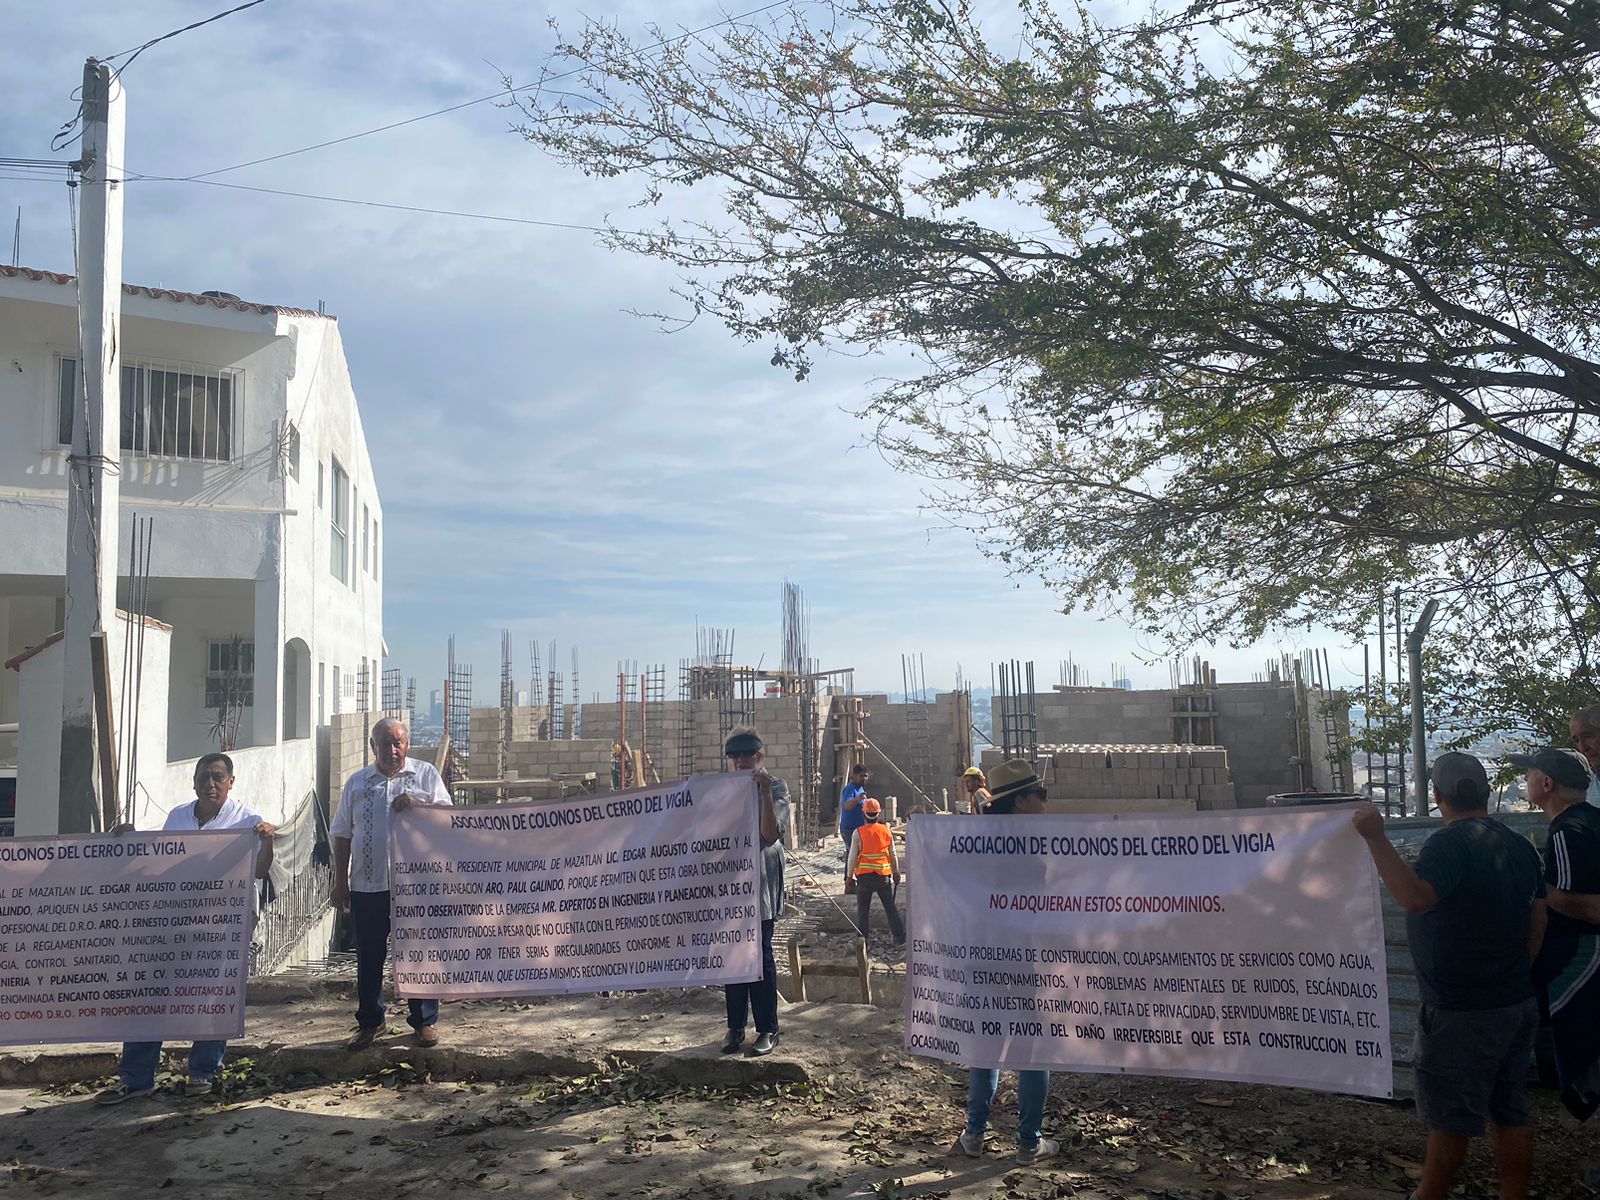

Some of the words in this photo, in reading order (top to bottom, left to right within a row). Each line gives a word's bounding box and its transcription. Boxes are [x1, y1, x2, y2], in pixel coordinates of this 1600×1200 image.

[451, 815, 510, 830] ASOCIACION
[512, 814, 527, 830] DE
[529, 808, 581, 829] COLONOS
[583, 806, 605, 822] DEL
[606, 798, 642, 818] CERRO
[645, 796, 663, 813] DEL
[666, 790, 693, 809] VIGIA
[58, 846, 80, 859] DEL
[84, 844, 123, 858] CERRO
[127, 843, 149, 856] DEL
[152, 842, 186, 855] VIGIA
[457, 861, 502, 873] PRESIDENTE
[506, 859, 546, 872] MUNICIPAL
[551, 858, 561, 870] DE
[564, 852, 602, 868] MAZATLAN
[622, 847, 646, 862] EDGAR
[650, 843, 688, 858] AUGUSTO
[691, 837, 730, 853] GONZALEZ
[950, 836, 1026, 855] ASOCIACION
[1030, 836, 1047, 855] DE
[1051, 837, 1118, 856] COLONOS
[1122, 837, 1148, 856] DEL
[1151, 836, 1199, 856] CERRO
[1202, 835, 1230, 855] DEL
[1232, 833, 1275, 853] VIGIA
[430, 883, 440, 895] DE
[485, 882, 504, 895] ARQ.
[507, 882, 527, 893] PAUL
[568, 875, 598, 890] PORQUE
[600, 871, 636, 886] PERMITEN
[639, 868, 656, 883] QUE
[659, 867, 676, 880] ESTA
[678, 864, 699, 878] OBRA
[701, 858, 753, 875] DENOMINADA
[12, 888, 24, 898] DE
[29, 886, 76, 897] MAZATLAN
[100, 884, 130, 894] EDGAR
[136, 882, 176, 892] AUGUSTO
[180, 880, 224, 891] GONZALEZ
[428, 904, 483, 917] OBSERVATORIO
[506, 902, 540, 915] EMPRESA
[559, 897, 597, 912] EXPERTOS
[599, 896, 609, 909] EN
[612, 891, 655, 908] INGENIERIA
[665, 885, 717, 902] PLANEACION,
[718, 884, 729, 897] SA
[730, 882, 741, 896] DE
[37, 904, 79, 916] APLIQUEN
[83, 903, 98, 913] LAS
[102, 901, 149, 912] SANCIONES
[153, 897, 226, 910] ADMINISTRATIVAS
[230, 897, 245, 908] QUE
[990, 894, 1008, 909] NO
[1011, 895, 1081, 914] ADQUIERAN
[1085, 896, 1122, 913] ESTOS
[1125, 896, 1225, 913] CONDOMINIOS.
[52, 922, 67, 932] DEL
[70, 921, 96, 931] D.R.O.
[99, 919, 121, 929] ARQ.
[132, 917, 169, 928] ERNESTO
[171, 915, 209, 926] GUZMAN
[428, 925, 496, 939] CONSTRUYENDOSE
[504, 924, 524, 937] PESAR
[526, 924, 541, 938] QUE
[542, 923, 554, 935] NO
[555, 921, 585, 935] CUENTA
[586, 920, 603, 933] CON
[615, 916, 648, 930] PERMISO
[650, 914, 660, 927] DE
[725, 906, 742, 919] PUES
[744, 905, 755, 918] NO
[15, 942, 26, 952] LA
[33, 937, 115, 951] REGLAMENTACION
[122, 935, 167, 946] MUNICIPAL
[174, 934, 186, 943] EN
[193, 932, 226, 942] MATERIA
[428, 949, 470, 962] RENOVADO
[476, 948, 492, 960] POR
[498, 946, 521, 959] TENER
[526, 946, 549, 958] SERIAS
[554, 941, 620, 957] IRREGULARIDADES
[626, 936, 670, 952] CONFORME
[691, 930, 741, 946] REGLAMENTO
[25, 958, 67, 969] CONTROL
[128, 952, 175, 963] ACTUANDO
[197, 950, 222, 960] FAVOR
[227, 950, 240, 960] DEL
[442, 973, 452, 984] DE
[453, 971, 494, 984] MAZATLAN,
[497, 970, 512, 983] QUE
[515, 967, 548, 980] USTEDES
[549, 966, 581, 979] MISMOS
[582, 963, 627, 978] RECONOCEN
[636, 961, 646, 974] LO
[646, 961, 662, 974] HAN
[664, 958, 690, 972] HECHO
[691, 955, 724, 970] PUBLICO.
[970, 946, 1022, 961] PROBLEMAS
[1026, 948, 1037, 962] DE
[1041, 949, 1120, 966] CONSTRUCCION,
[1123, 951, 1217, 966] COLAPSAMIENTOS
[1221, 953, 1235, 967] DE
[1239, 952, 1295, 967] SERVICIOS
[1299, 952, 1335, 968] COMO
[1340, 953, 1374, 972] AGUA,
[117, 972, 128, 982] SA
[134, 971, 146, 981] DE
[174, 968, 219, 979] SOLAPANDO
[224, 968, 238, 978] LAS
[973, 971, 1068, 988] ESTACIONAMIENTOS.
[1086, 976, 1147, 991] PROBLEMAS
[1153, 978, 1225, 993] AMBIENTALES
[1232, 979, 1247, 993] DE
[1253, 979, 1298, 996] RUIDOS,
[1306, 977, 1378, 999] ESCÁNDALOS
[58, 991, 100, 1003] ENCANTO
[174, 986, 223, 997] SOLICITAMOS
[226, 986, 236, 996] LA
[15, 1010, 43, 1020] COMO
[79, 1008, 96, 1017] POR
[100, 1004, 167, 1017] PROPORCIONAR
[170, 1004, 195, 1015] DATOS
[197, 1004, 226, 1015] FALSOS
[992, 997, 1035, 1010] NUESTRO
[1037, 999, 1102, 1016] PATRIMONIO,
[1104, 1002, 1135, 1016] FALTA
[1137, 1003, 1150, 1017] DE
[1153, 1003, 1219, 1021] PRIVACIDAD,
[1222, 1005, 1299, 1022] SERVIDUMBRE
[1302, 1008, 1317, 1023] DE
[1319, 1009, 1354, 1028] VISTA,
[1357, 1011, 1380, 1029] ETC.
[911, 1034, 961, 1056] OCASIONANDO.
[982, 1021, 1002, 1036] POR
[1009, 1022, 1043, 1036] FAVOR
[1050, 1023, 1069, 1037] DEL
[1075, 1023, 1105, 1040] DAÑO
[1113, 1028, 1183, 1044] IRREVERSIBLE
[1191, 1031, 1215, 1047] QUE
[1223, 1031, 1251, 1046] ESTA
[1259, 1032, 1347, 1054] CONSTRUCCION
[1356, 1040, 1382, 1059] ESTA
